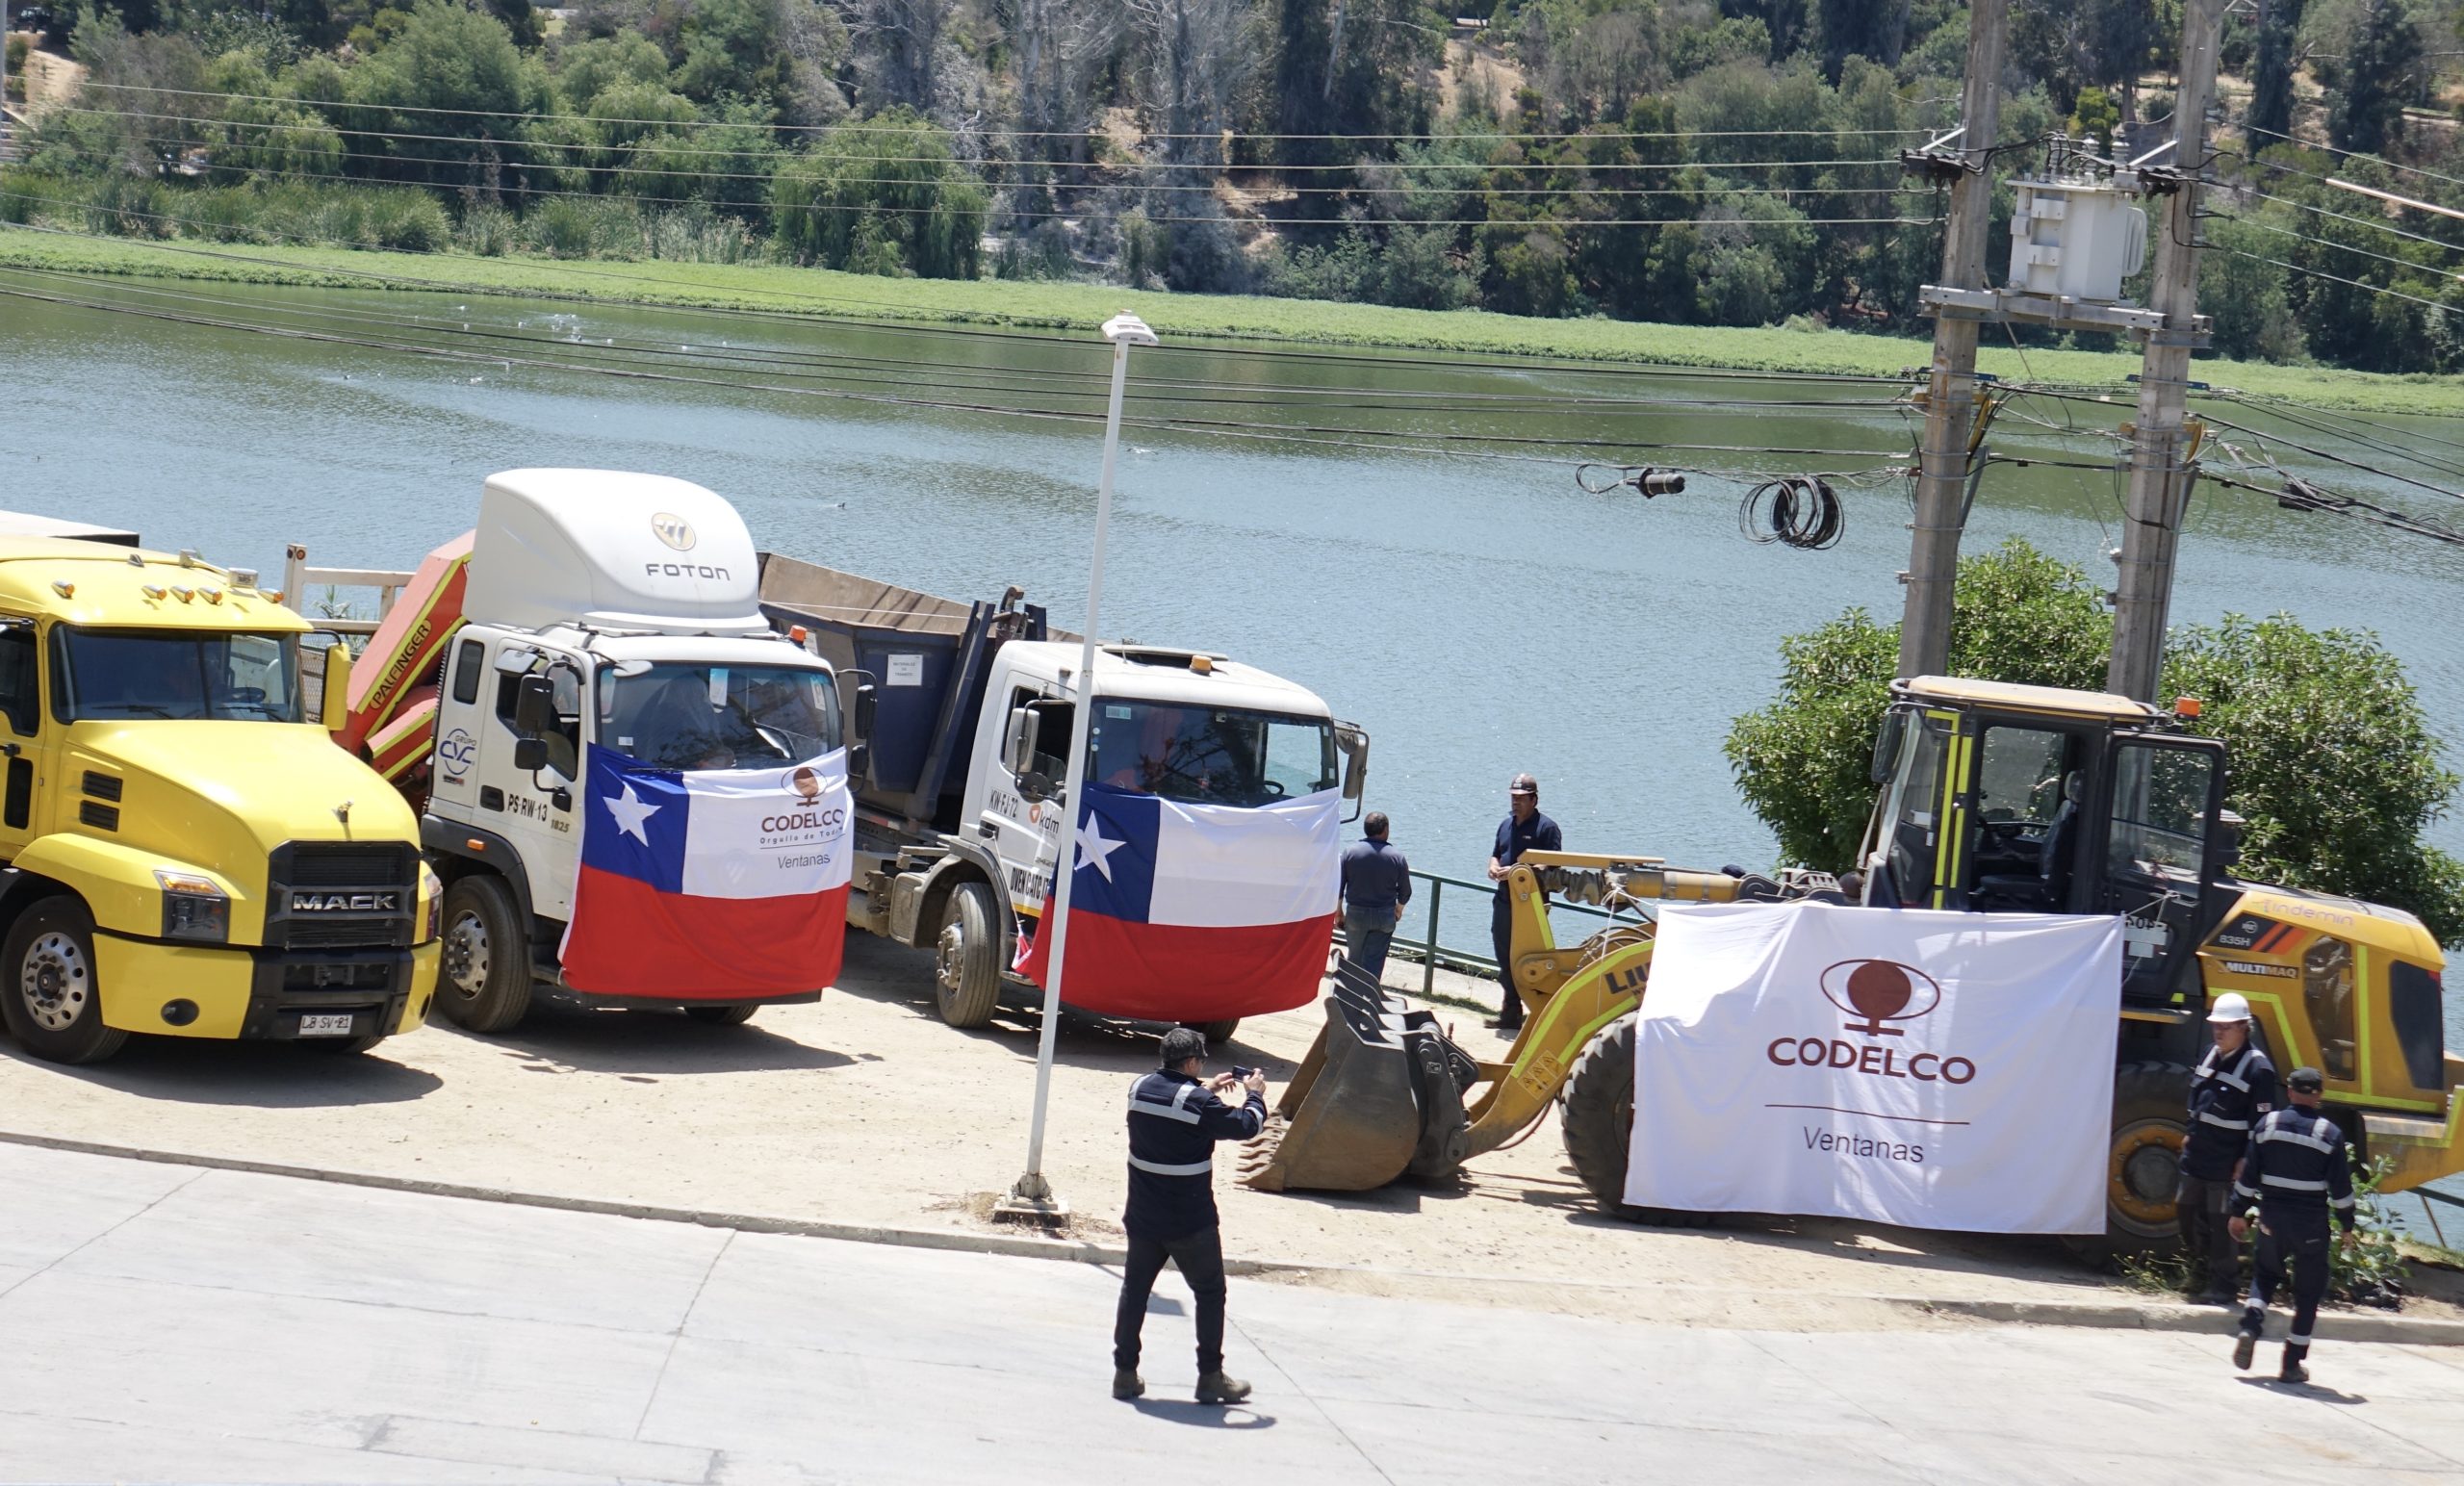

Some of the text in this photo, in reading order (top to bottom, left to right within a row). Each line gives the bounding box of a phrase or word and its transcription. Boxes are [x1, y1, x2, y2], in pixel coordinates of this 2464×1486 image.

[646, 563, 731, 581] FOTON
[372, 623, 430, 705] PALFINGER
[455, 734, 477, 746] GRUPO
[551, 819, 570, 833] 1825
[761, 808, 844, 833] CODELCO
[1040, 810, 1060, 833] kdm
[759, 834, 799, 845] Orgullo
[778, 854, 831, 869] Ventanas
[293, 895, 395, 910] MACK
[2220, 935, 2251, 947] 835H
[2225, 961, 2297, 979] MULTIMAQ
[1767, 1037, 1976, 1085] CODELCO
[1804, 1125, 1924, 1164] Ventanas
